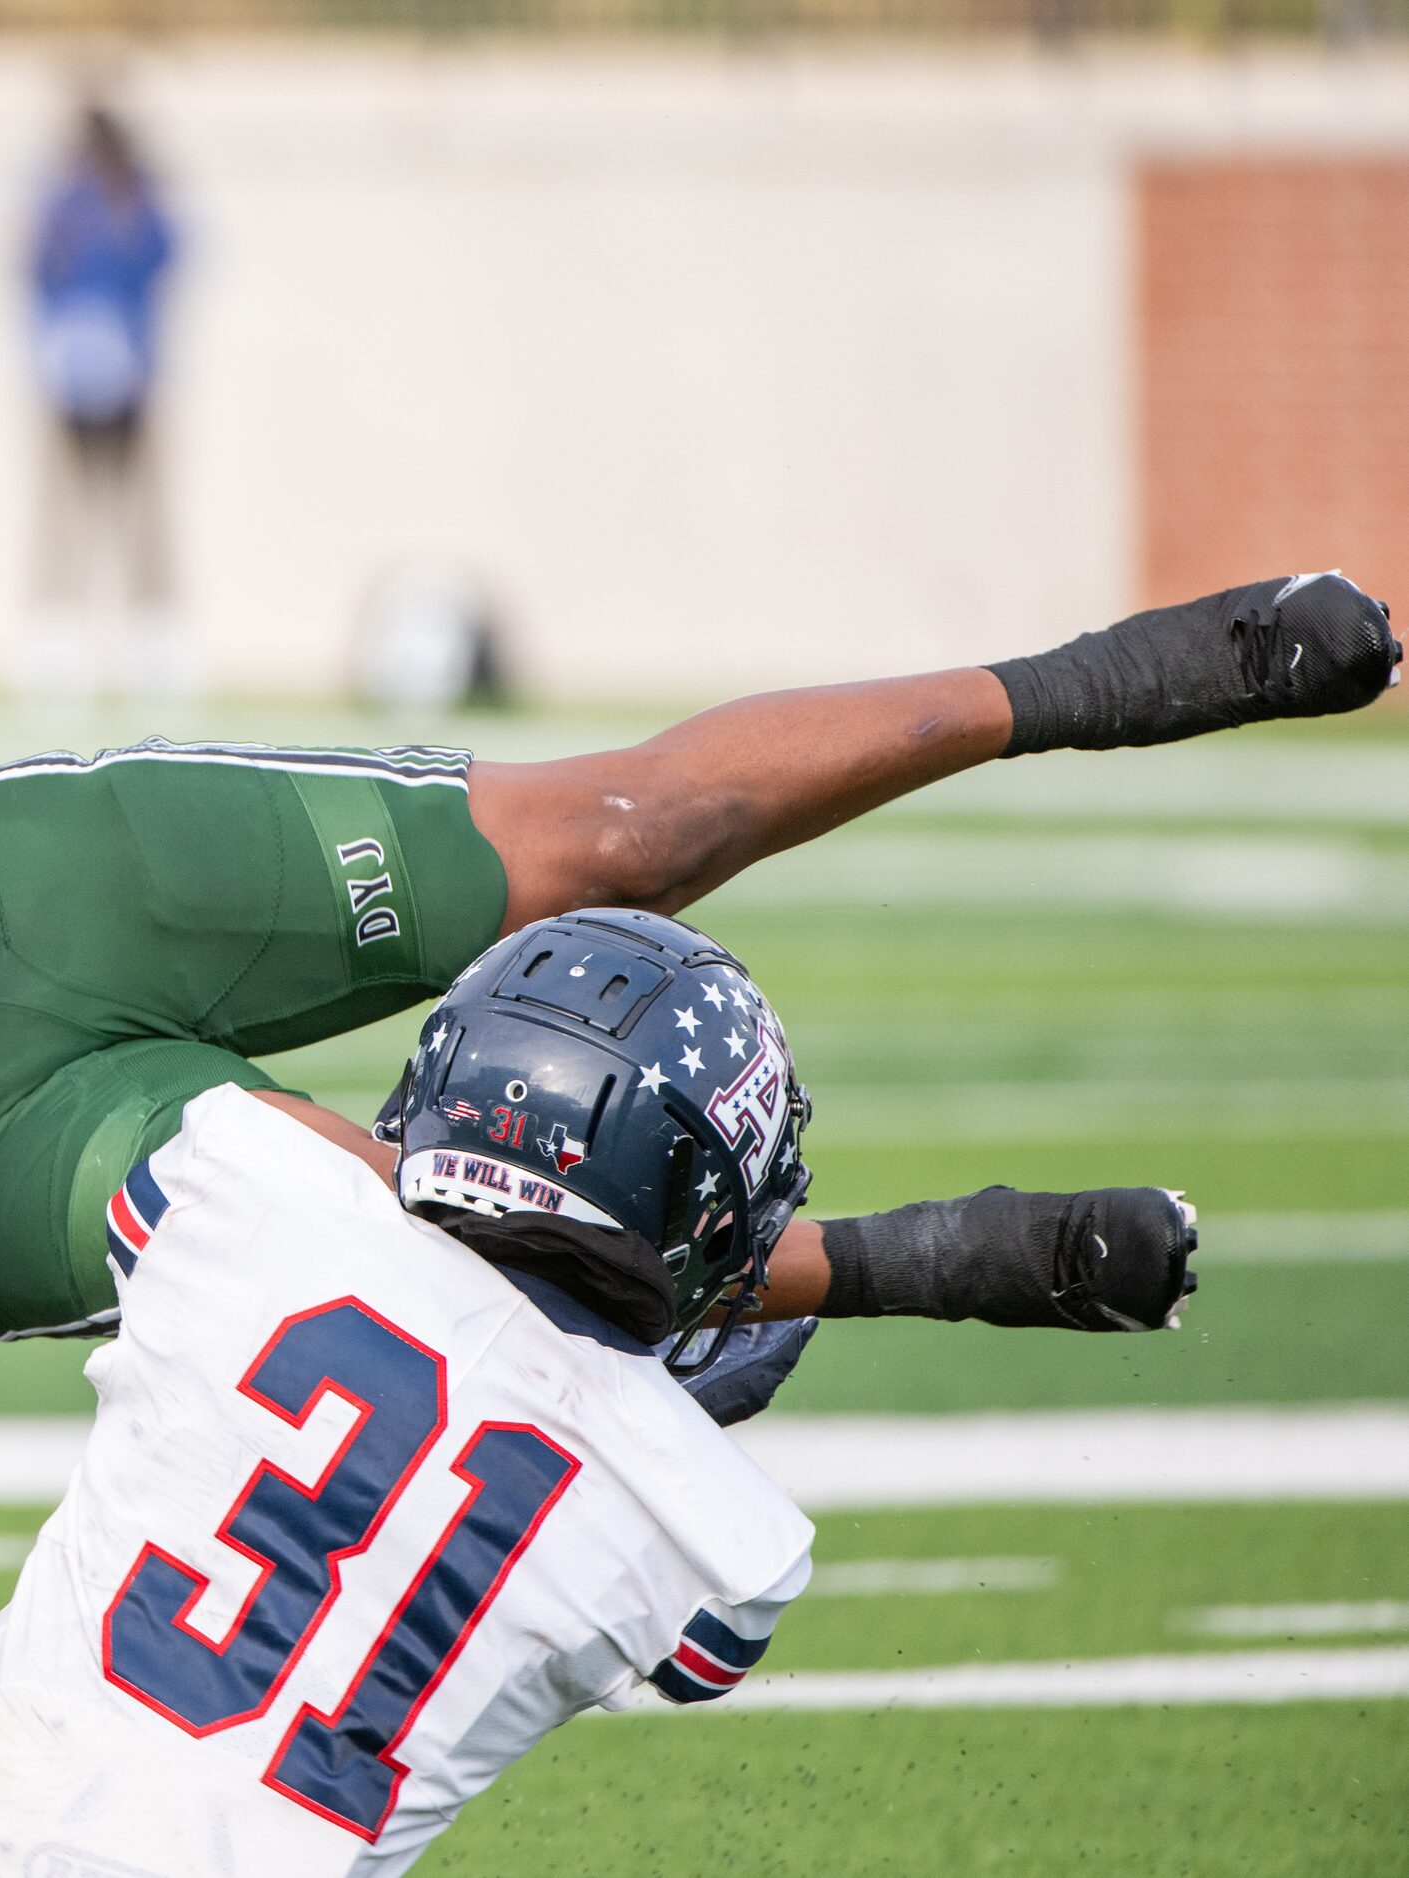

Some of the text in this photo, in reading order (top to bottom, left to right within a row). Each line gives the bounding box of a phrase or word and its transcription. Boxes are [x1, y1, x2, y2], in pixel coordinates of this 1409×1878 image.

[487, 1105, 528, 1150] 31
[704, 1016, 790, 1200] A
[432, 1152, 567, 1214] WE WILL WIN
[101, 1294, 583, 1845] 31
